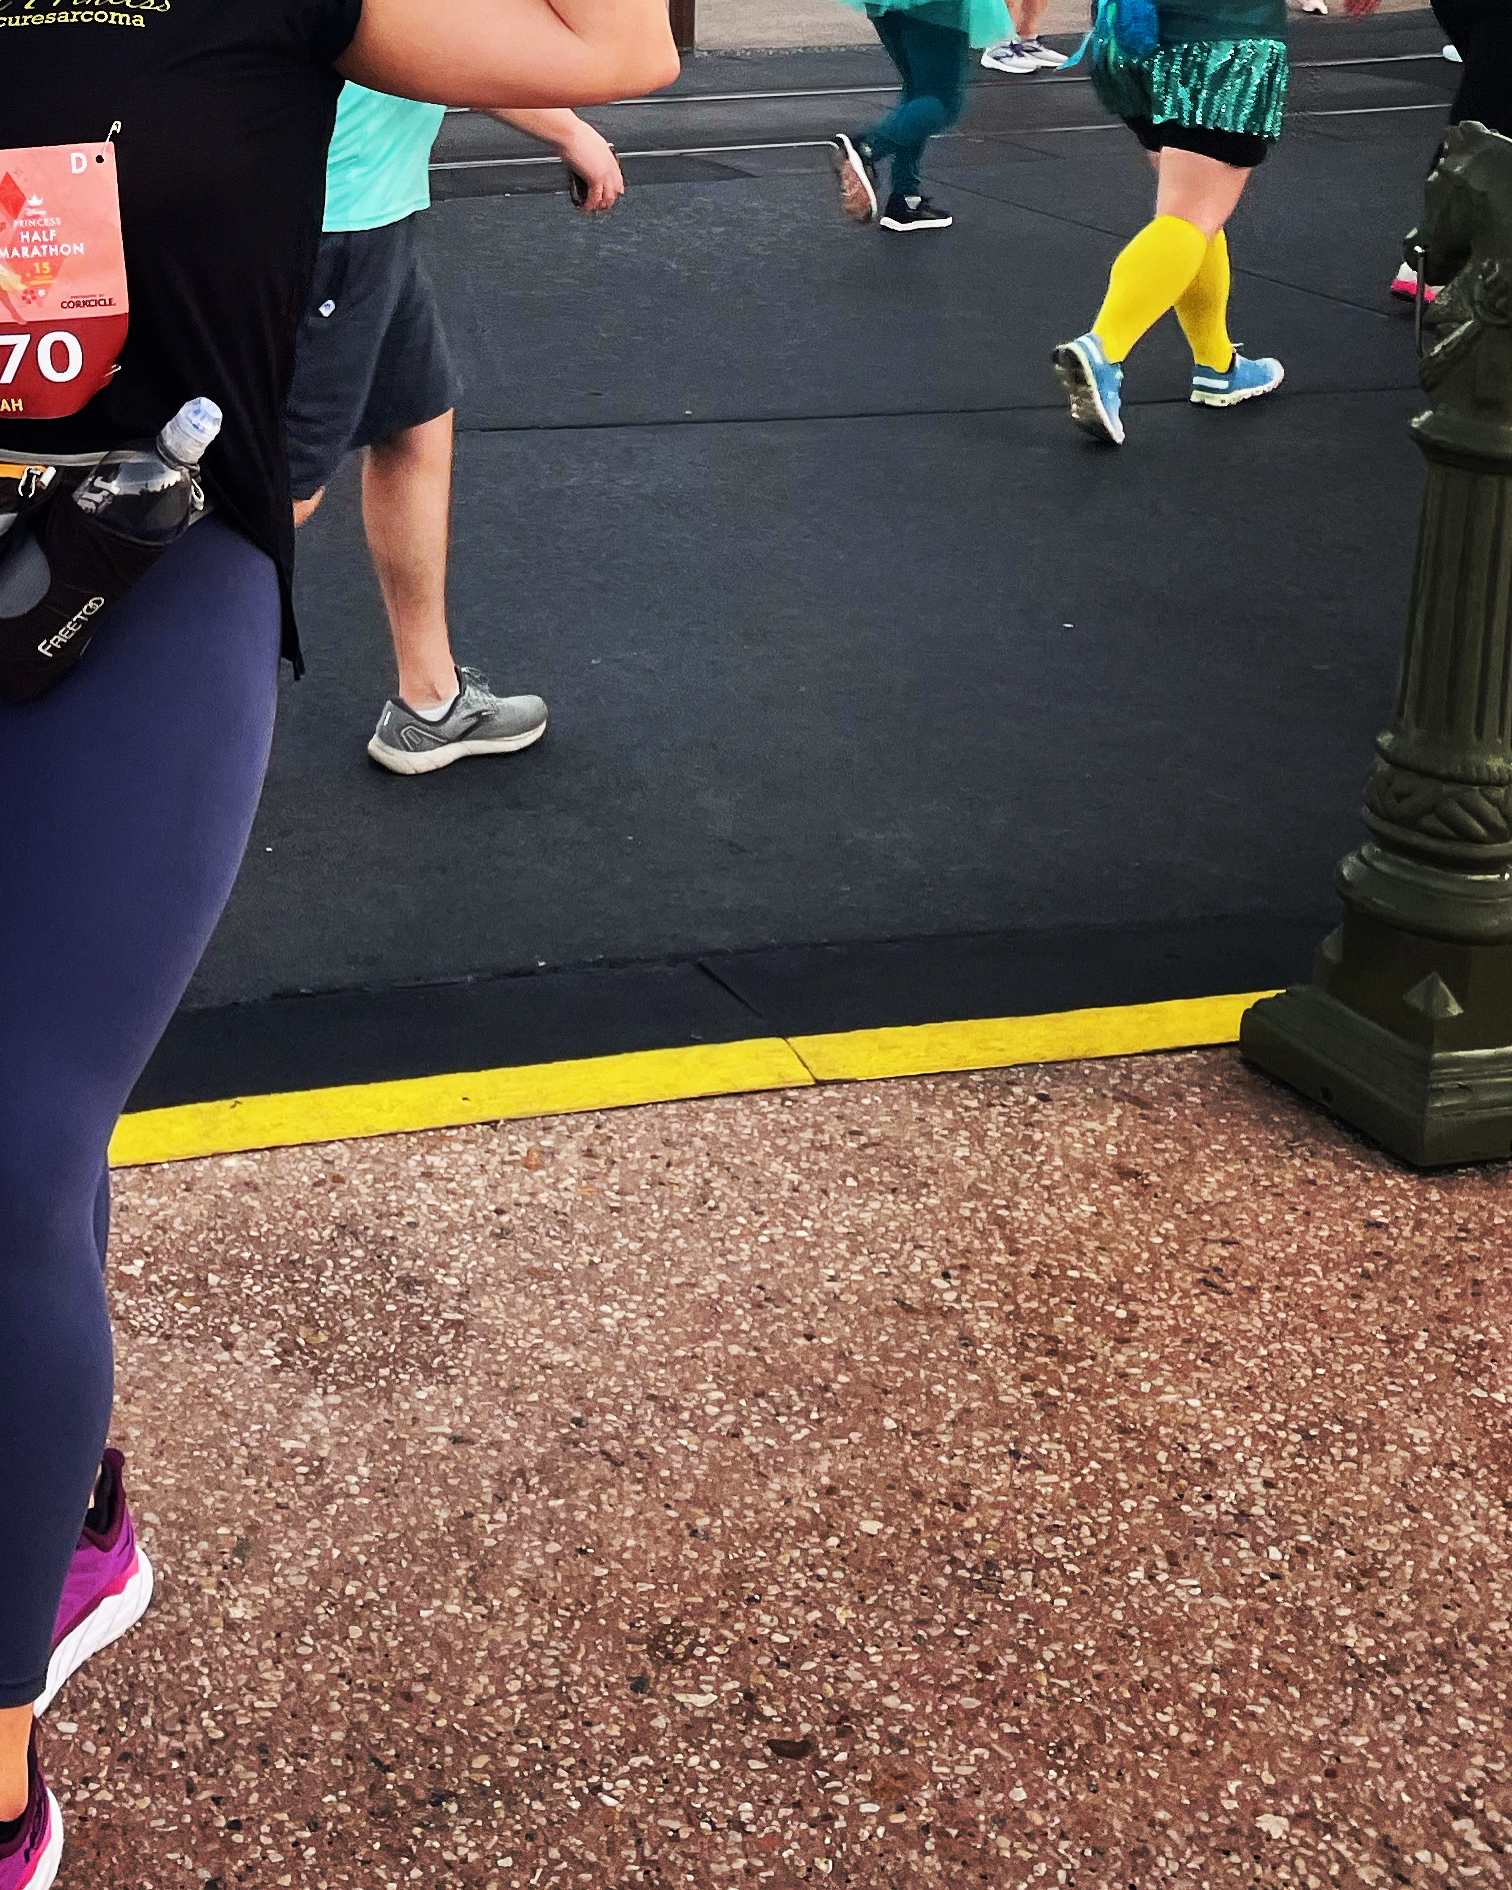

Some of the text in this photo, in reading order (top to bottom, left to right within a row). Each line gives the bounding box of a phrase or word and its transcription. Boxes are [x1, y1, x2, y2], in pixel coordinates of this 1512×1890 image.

[70, 152, 88, 175] D
[12, 217, 62, 229] PRINCESS
[20, 229, 57, 243] HALF
[33, 261, 51, 274] 15
